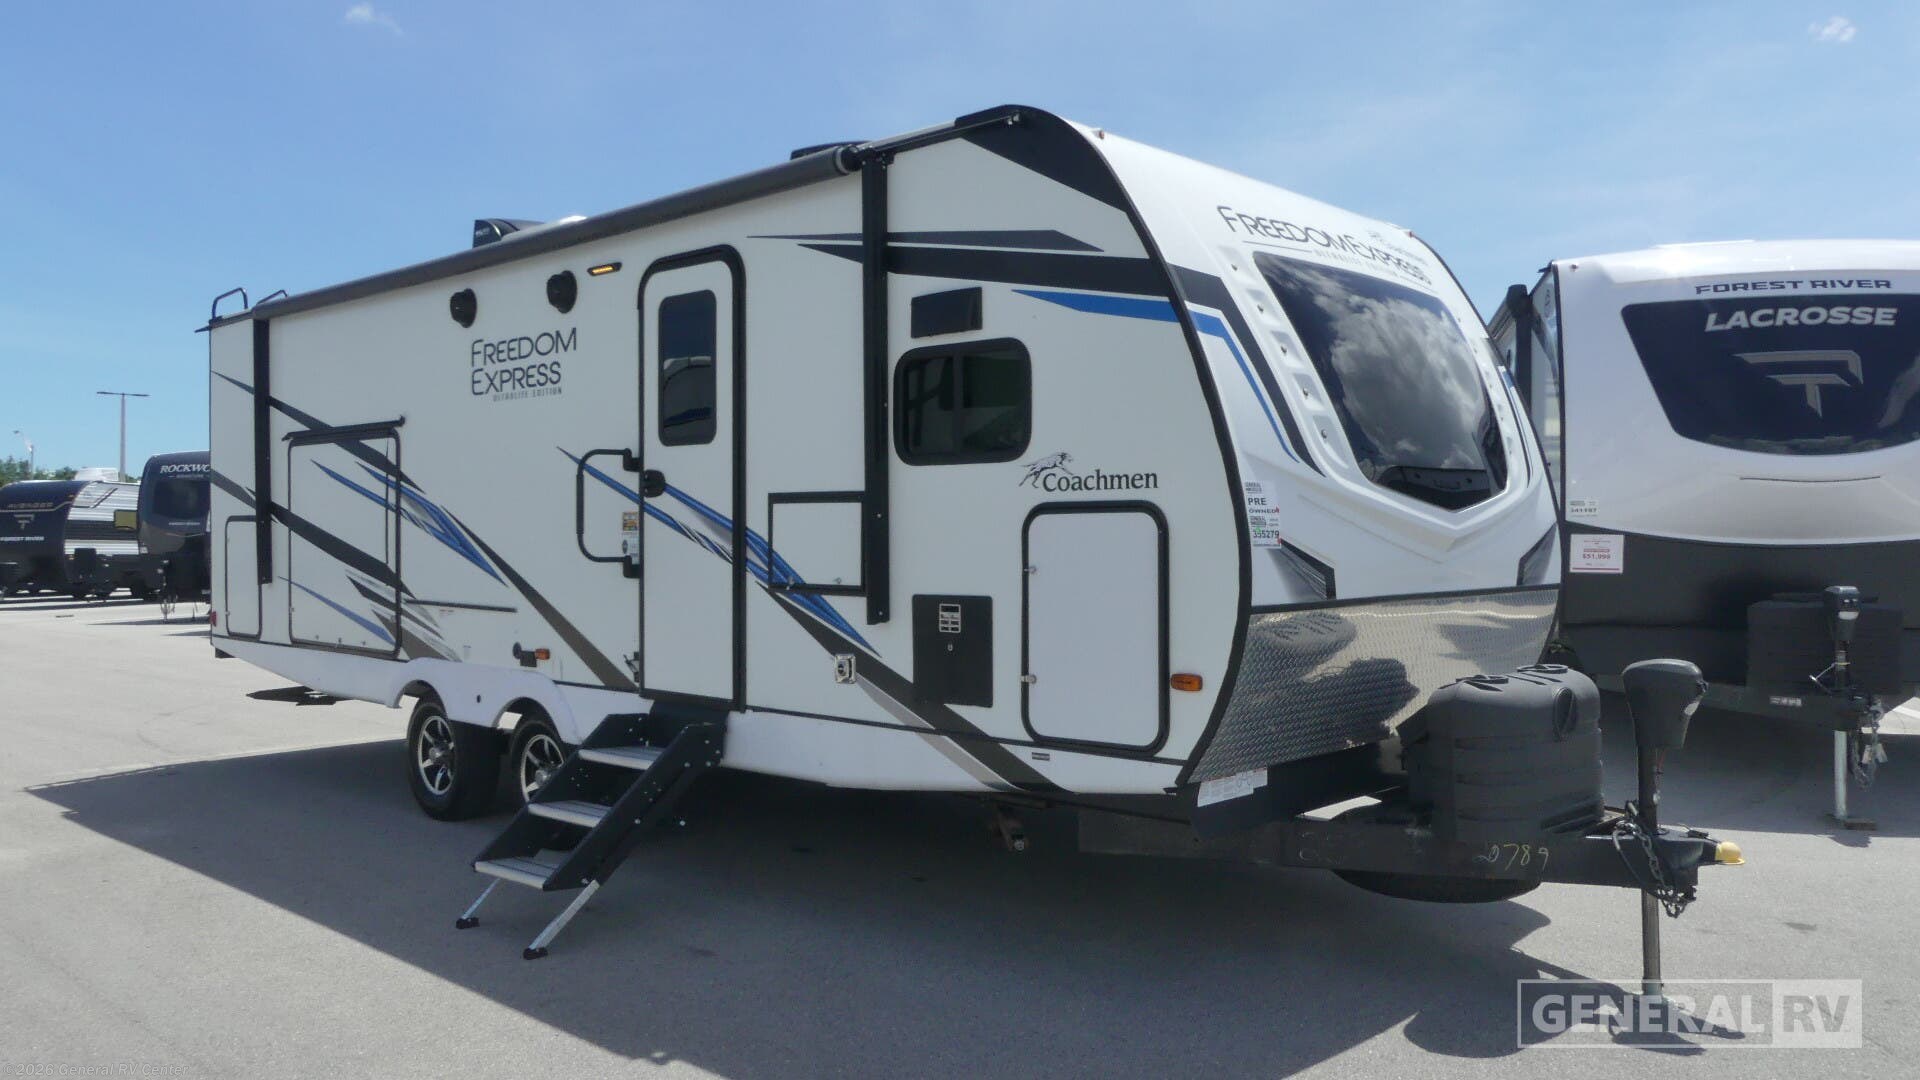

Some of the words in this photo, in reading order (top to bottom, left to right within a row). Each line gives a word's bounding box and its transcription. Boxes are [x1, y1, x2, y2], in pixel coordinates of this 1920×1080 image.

[1695, 280, 1804, 295] FOREST
[1810, 279, 1893, 290] RIVER
[1705, 306, 1898, 332] LACROSSE
[471, 327, 577, 368] FREEDOM
[471, 361, 562, 396] EXPRESS
[1042, 468, 1159, 492] Coachmen
[1247, 497, 1267, 506] PRE
